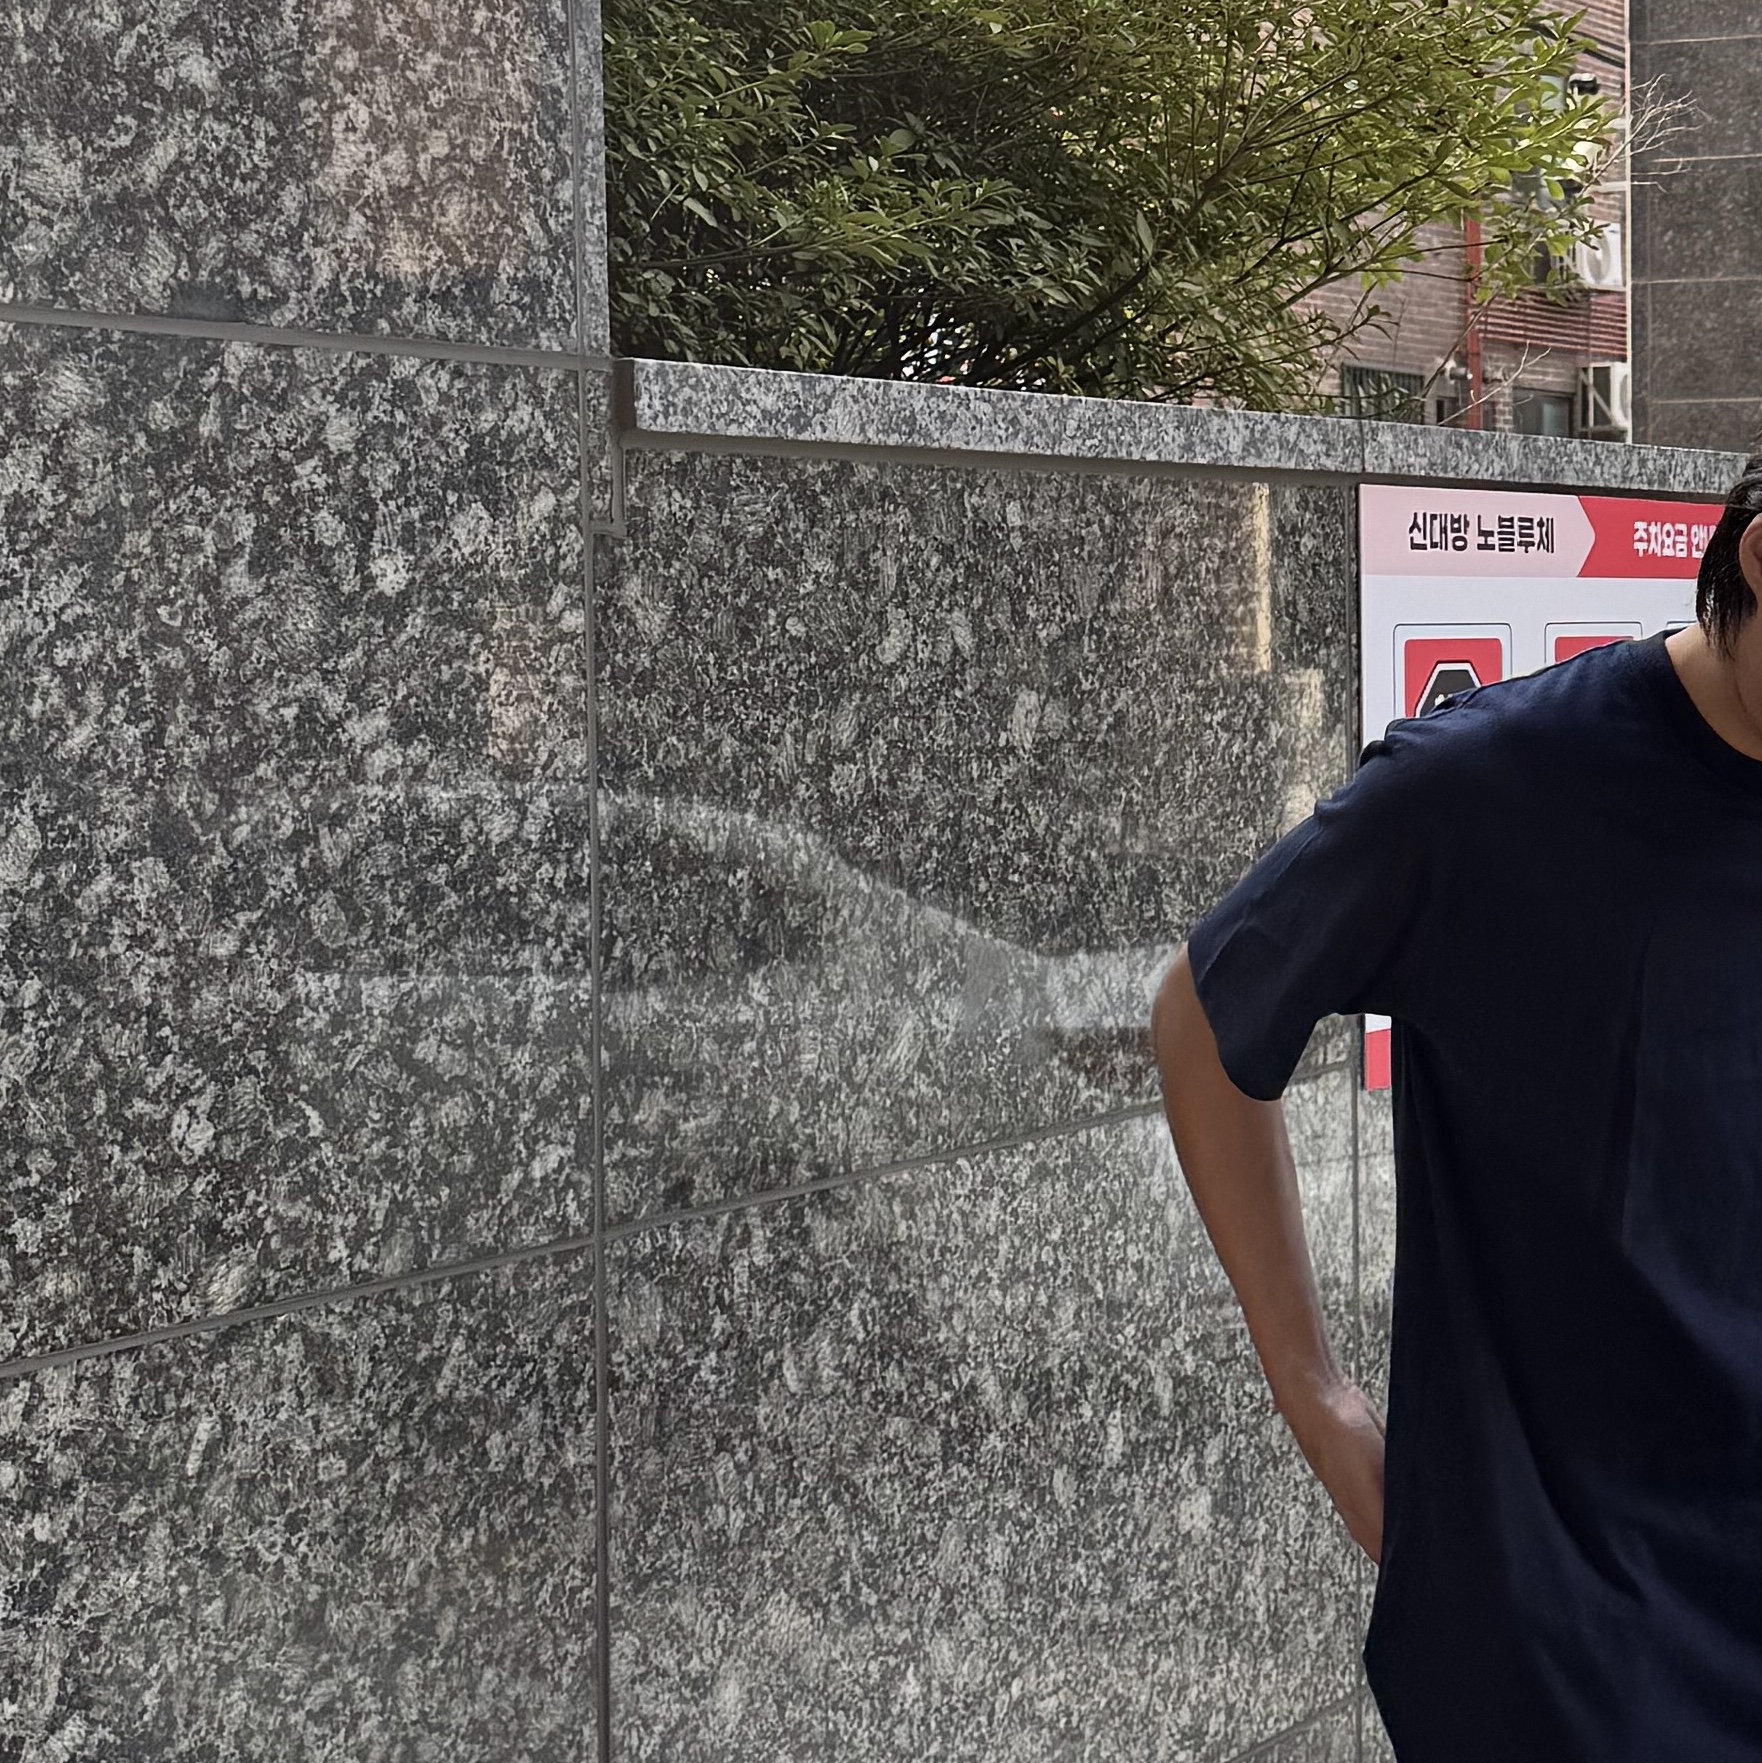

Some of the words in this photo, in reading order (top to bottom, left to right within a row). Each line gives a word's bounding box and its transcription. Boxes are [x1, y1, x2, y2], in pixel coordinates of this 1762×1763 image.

[1408, 511, 1469, 552] 신대방
[1476, 515, 1555, 554] 노블루체
[1633, 521, 1688, 557] 주차요금
